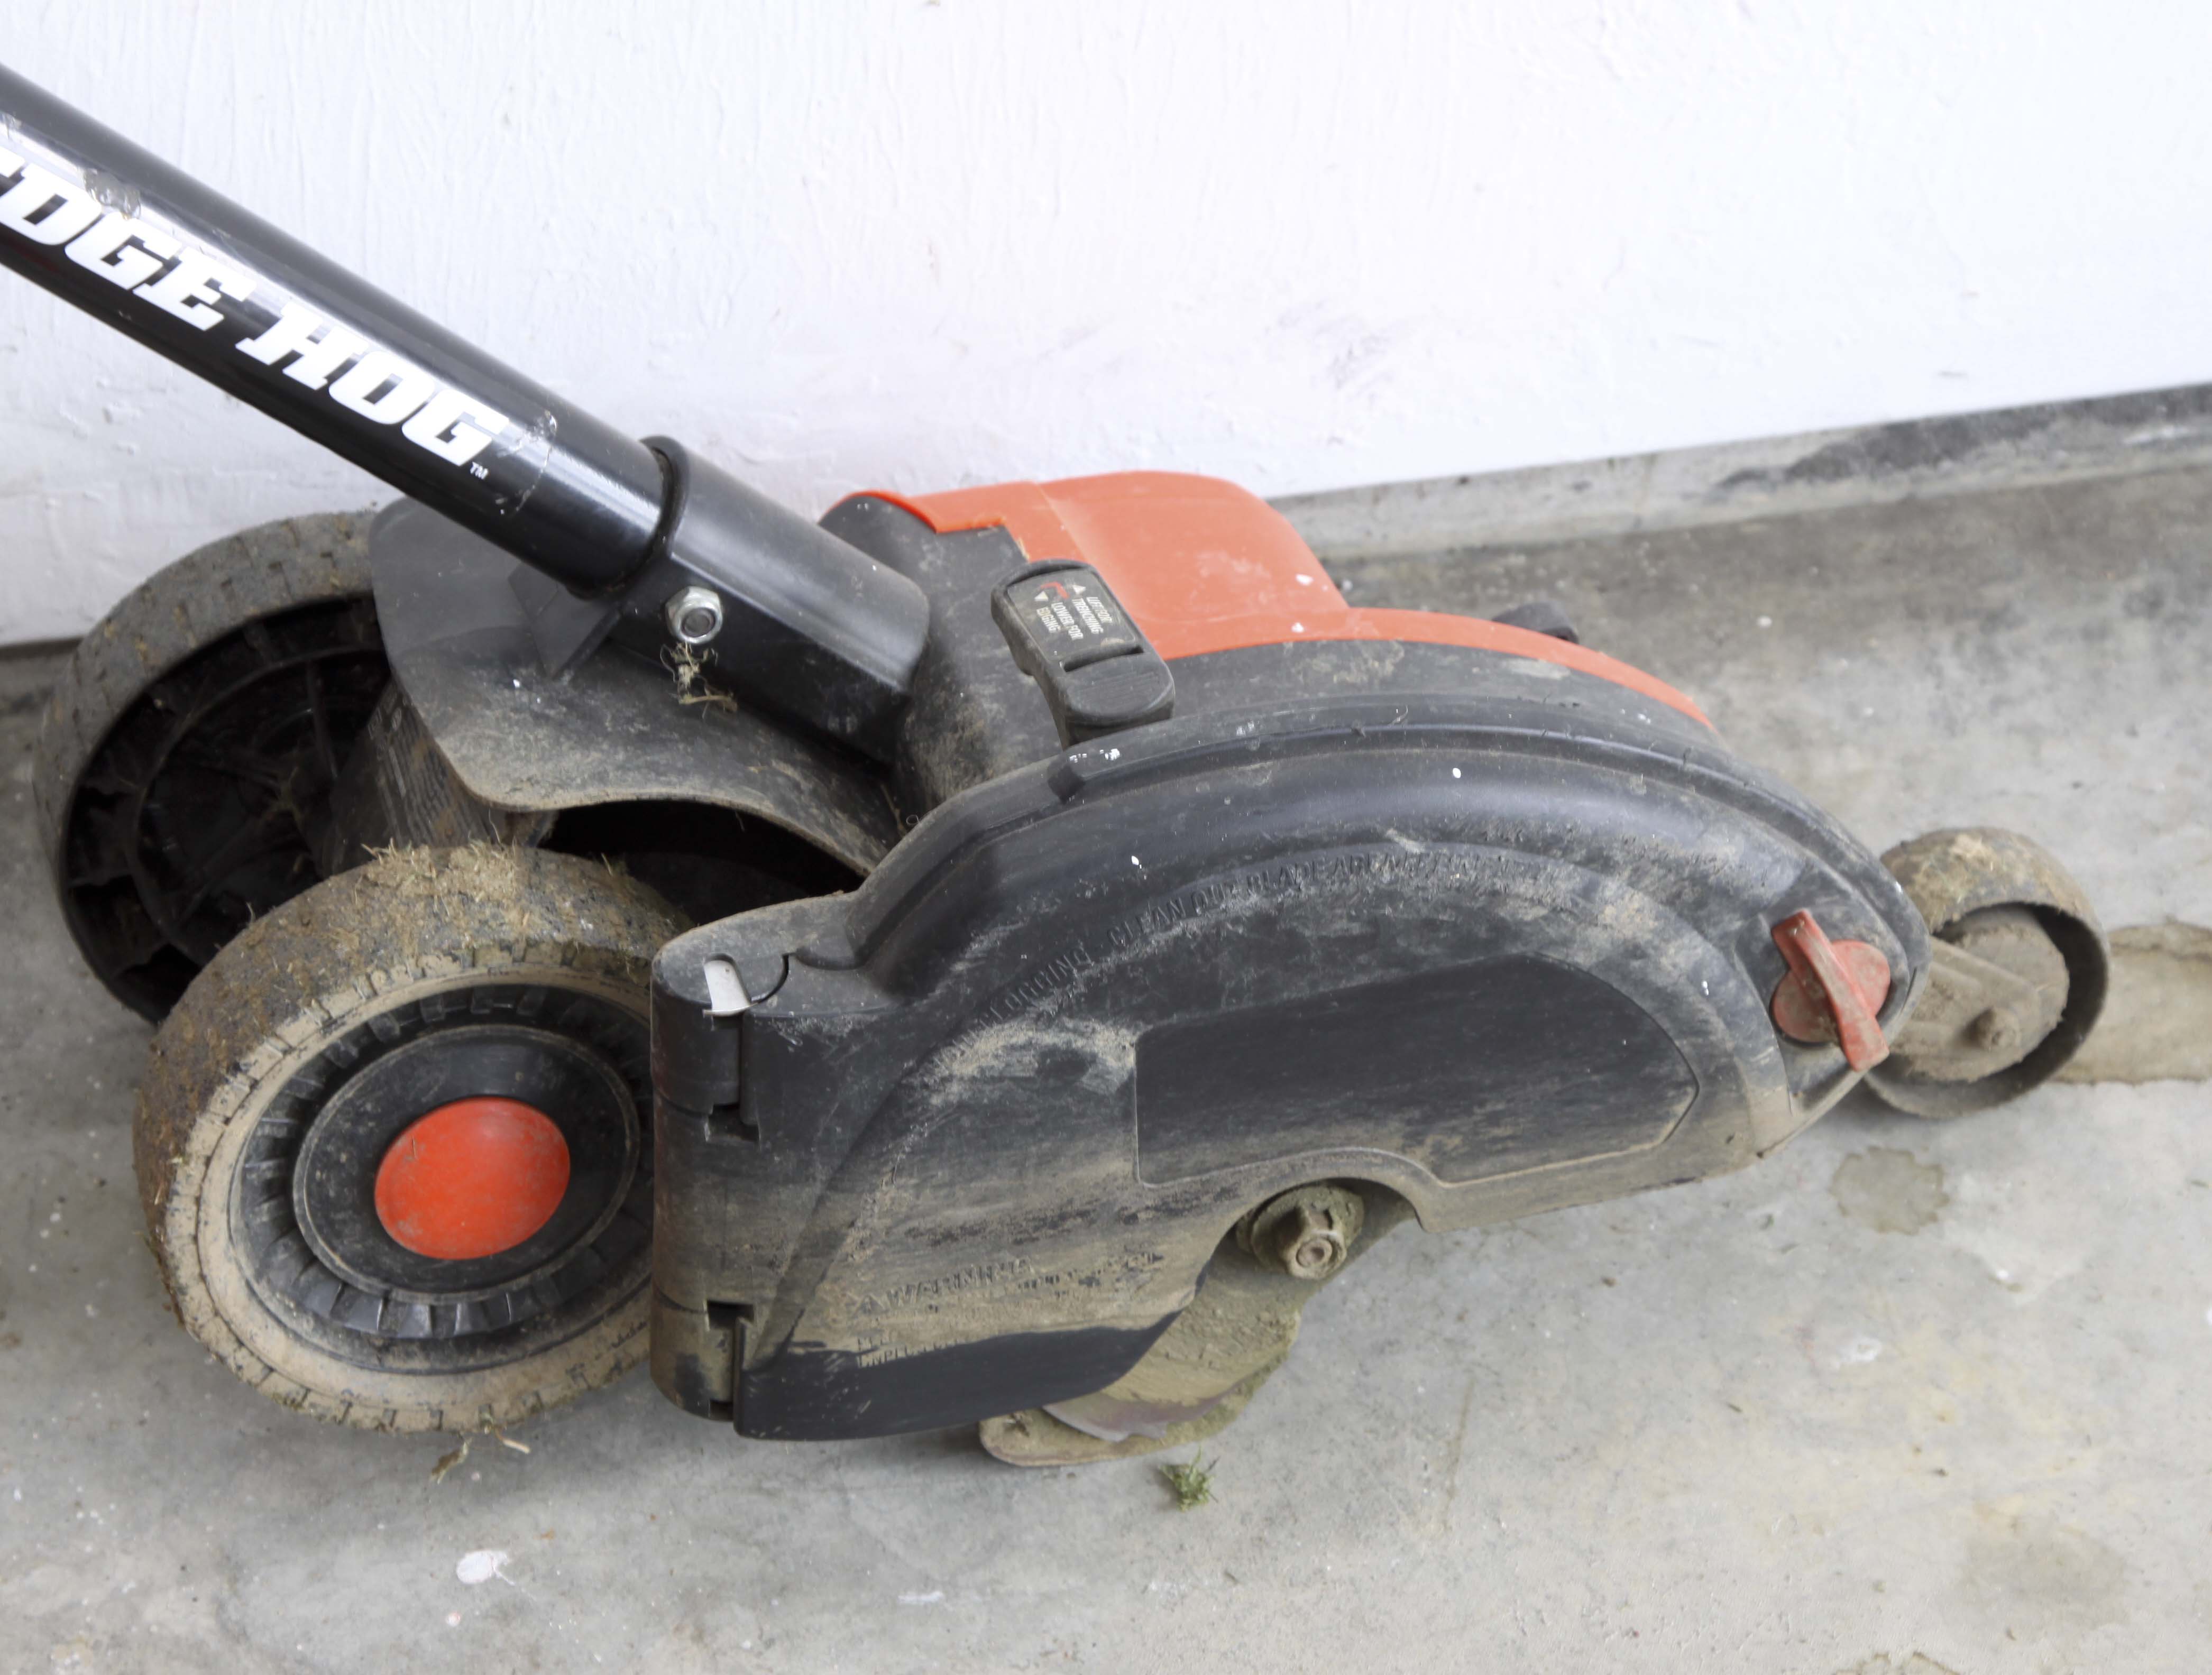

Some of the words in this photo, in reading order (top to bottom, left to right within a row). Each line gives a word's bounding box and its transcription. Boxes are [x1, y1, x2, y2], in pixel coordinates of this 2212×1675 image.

[235, 300, 510, 466] HOG
[1036, 606, 1061, 633] EDGING
[1051, 602, 1075, 627] LOWER
[1066, 624, 1084, 641] FOR
[1071, 597, 1104, 634] TRENCHING
[1094, 609, 1113, 623] FOR
[1107, 896, 1187, 947] CLEAN
[885, 1255, 1036, 1307] WARNING
